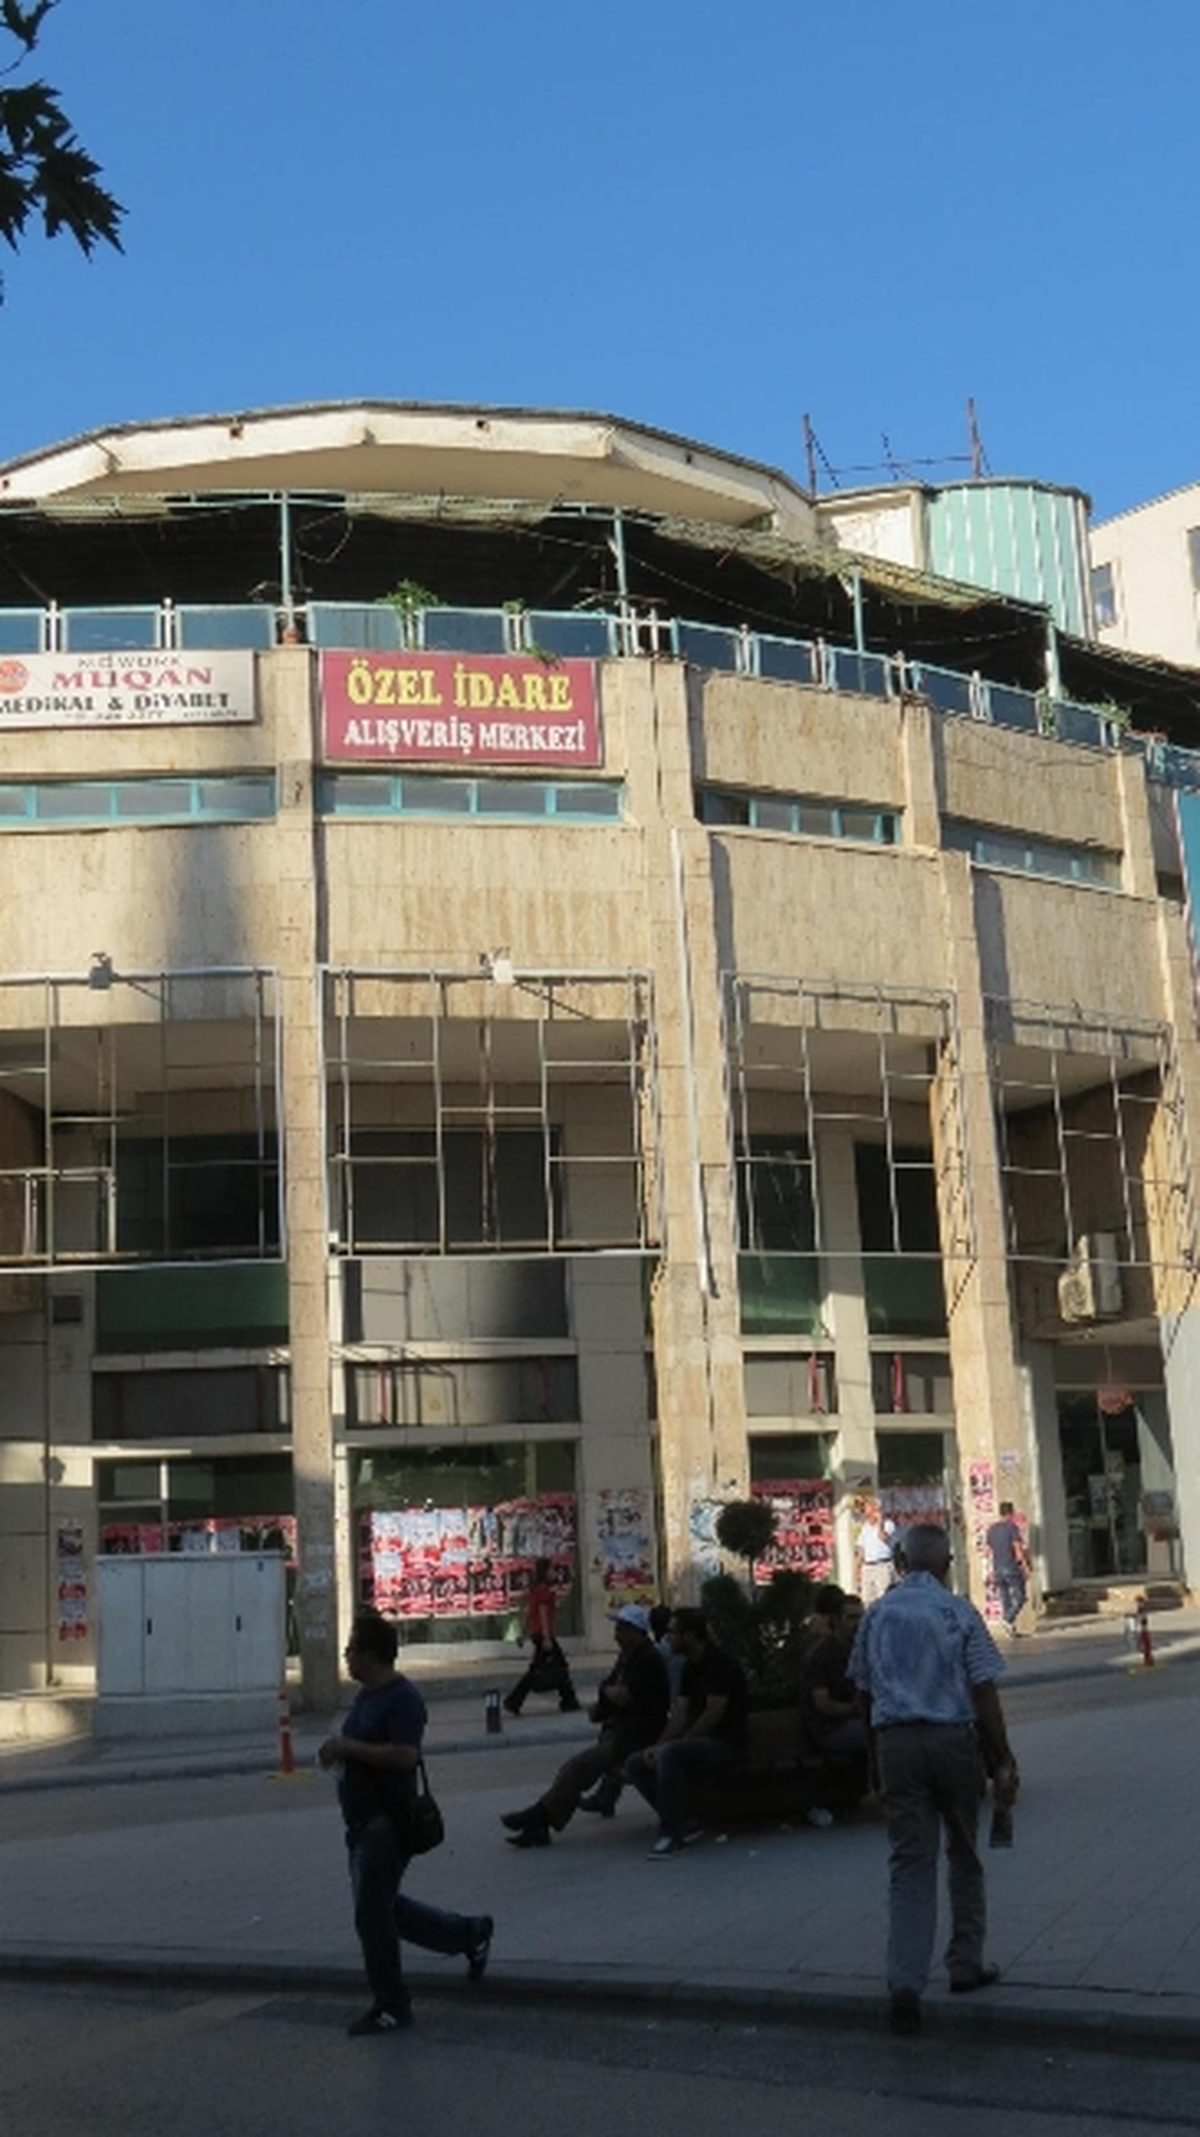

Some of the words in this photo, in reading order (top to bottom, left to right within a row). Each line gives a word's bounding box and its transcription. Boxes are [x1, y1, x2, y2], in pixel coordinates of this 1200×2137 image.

[347, 657, 442, 706] ÖZEL
[453, 661, 573, 711] İDARE
[107, 697, 122, 711] &
[344, 715, 474, 754] ALIŞVERİŞ
[479, 720, 585, 752] MERKEZİ
